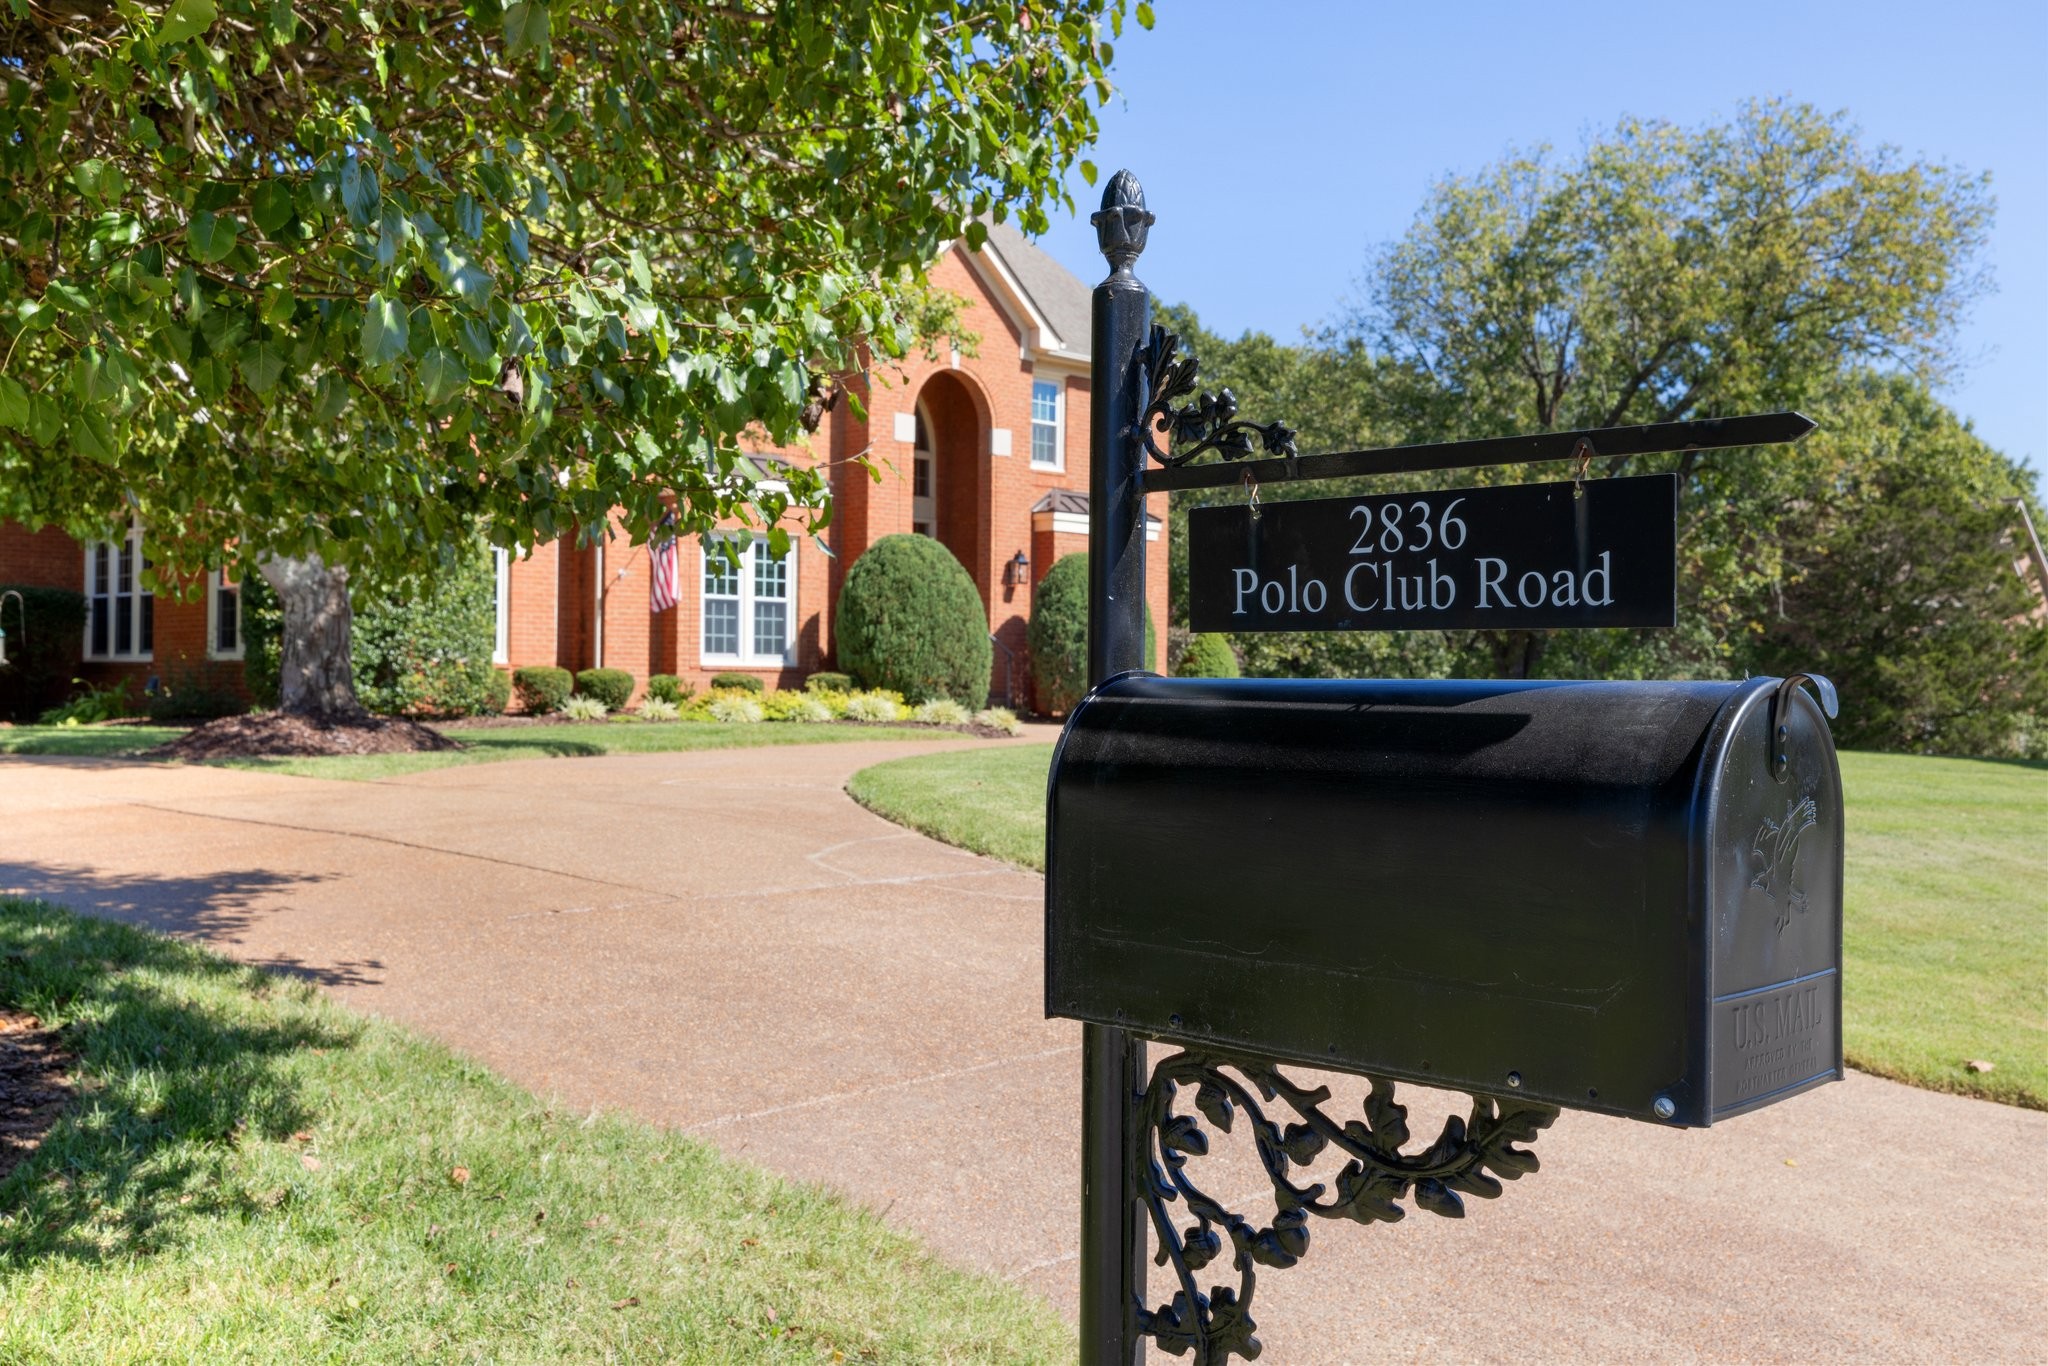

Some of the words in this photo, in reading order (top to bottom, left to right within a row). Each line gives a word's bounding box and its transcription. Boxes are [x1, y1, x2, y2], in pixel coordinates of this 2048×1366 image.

[1348, 498, 1467, 554] 2836
[1232, 564, 1327, 614] Polo
[1344, 558, 1456, 612] Club
[1474, 550, 1615, 609] Road
[1732, 1001, 1769, 1050] U.S.
[1774, 986, 1822, 1041] MAIL
